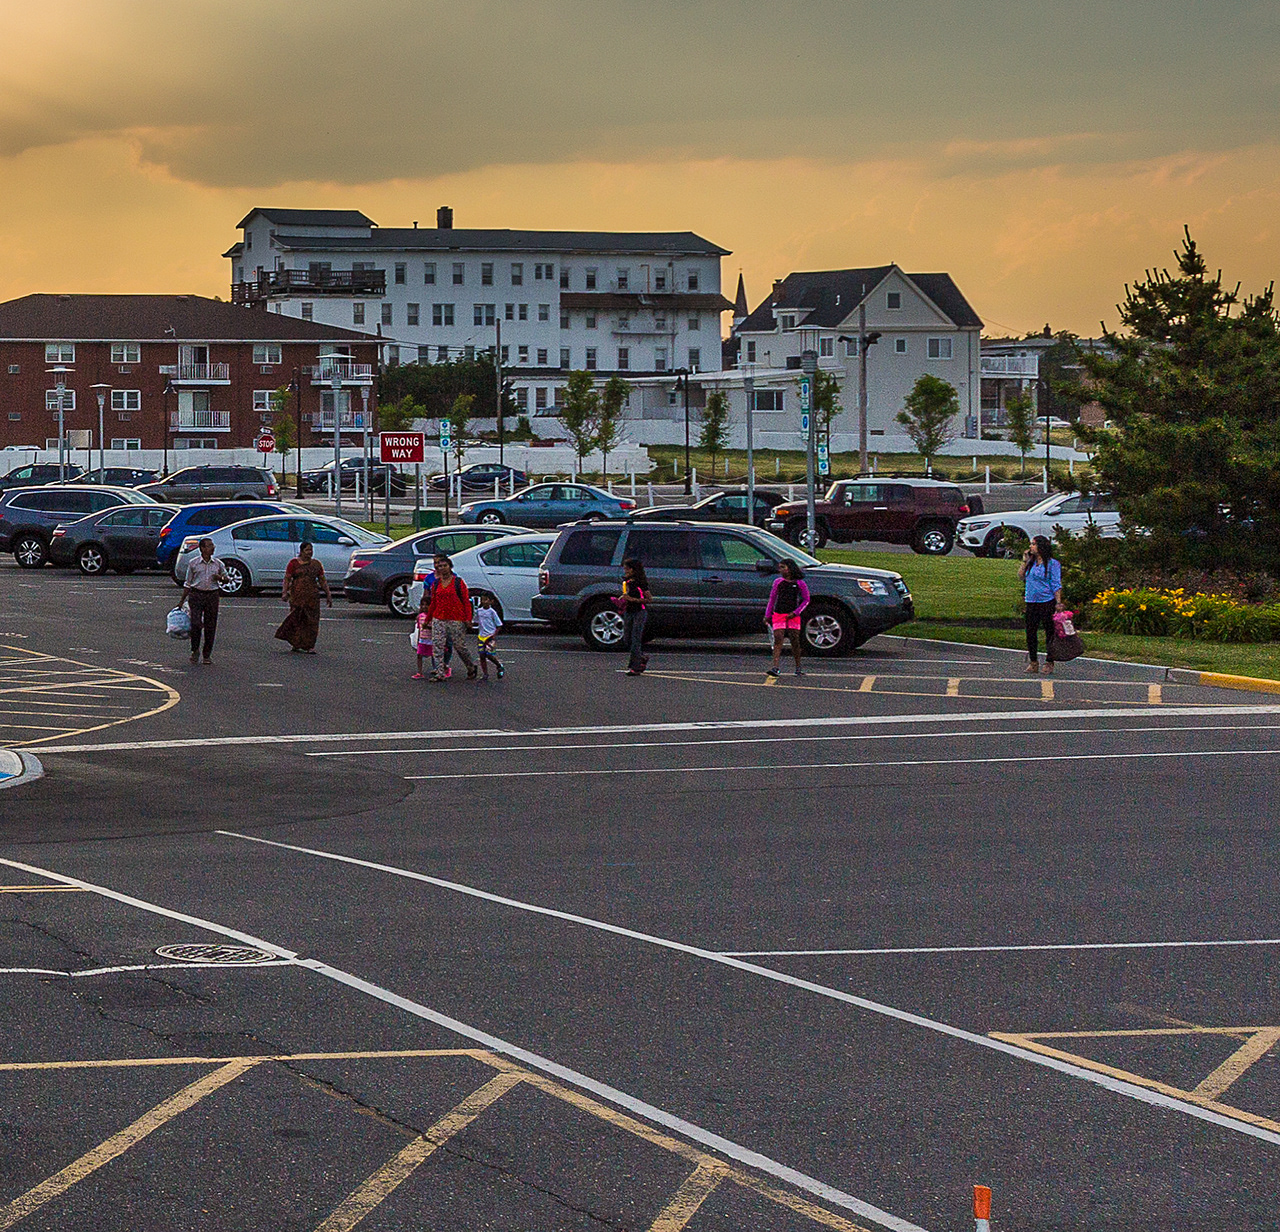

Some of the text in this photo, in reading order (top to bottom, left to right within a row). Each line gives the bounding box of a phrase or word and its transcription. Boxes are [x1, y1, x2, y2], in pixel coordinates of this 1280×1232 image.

[258, 440, 275, 448] STOP
[384, 437, 420, 446] WRONG
[391, 449, 413, 458] WAY
